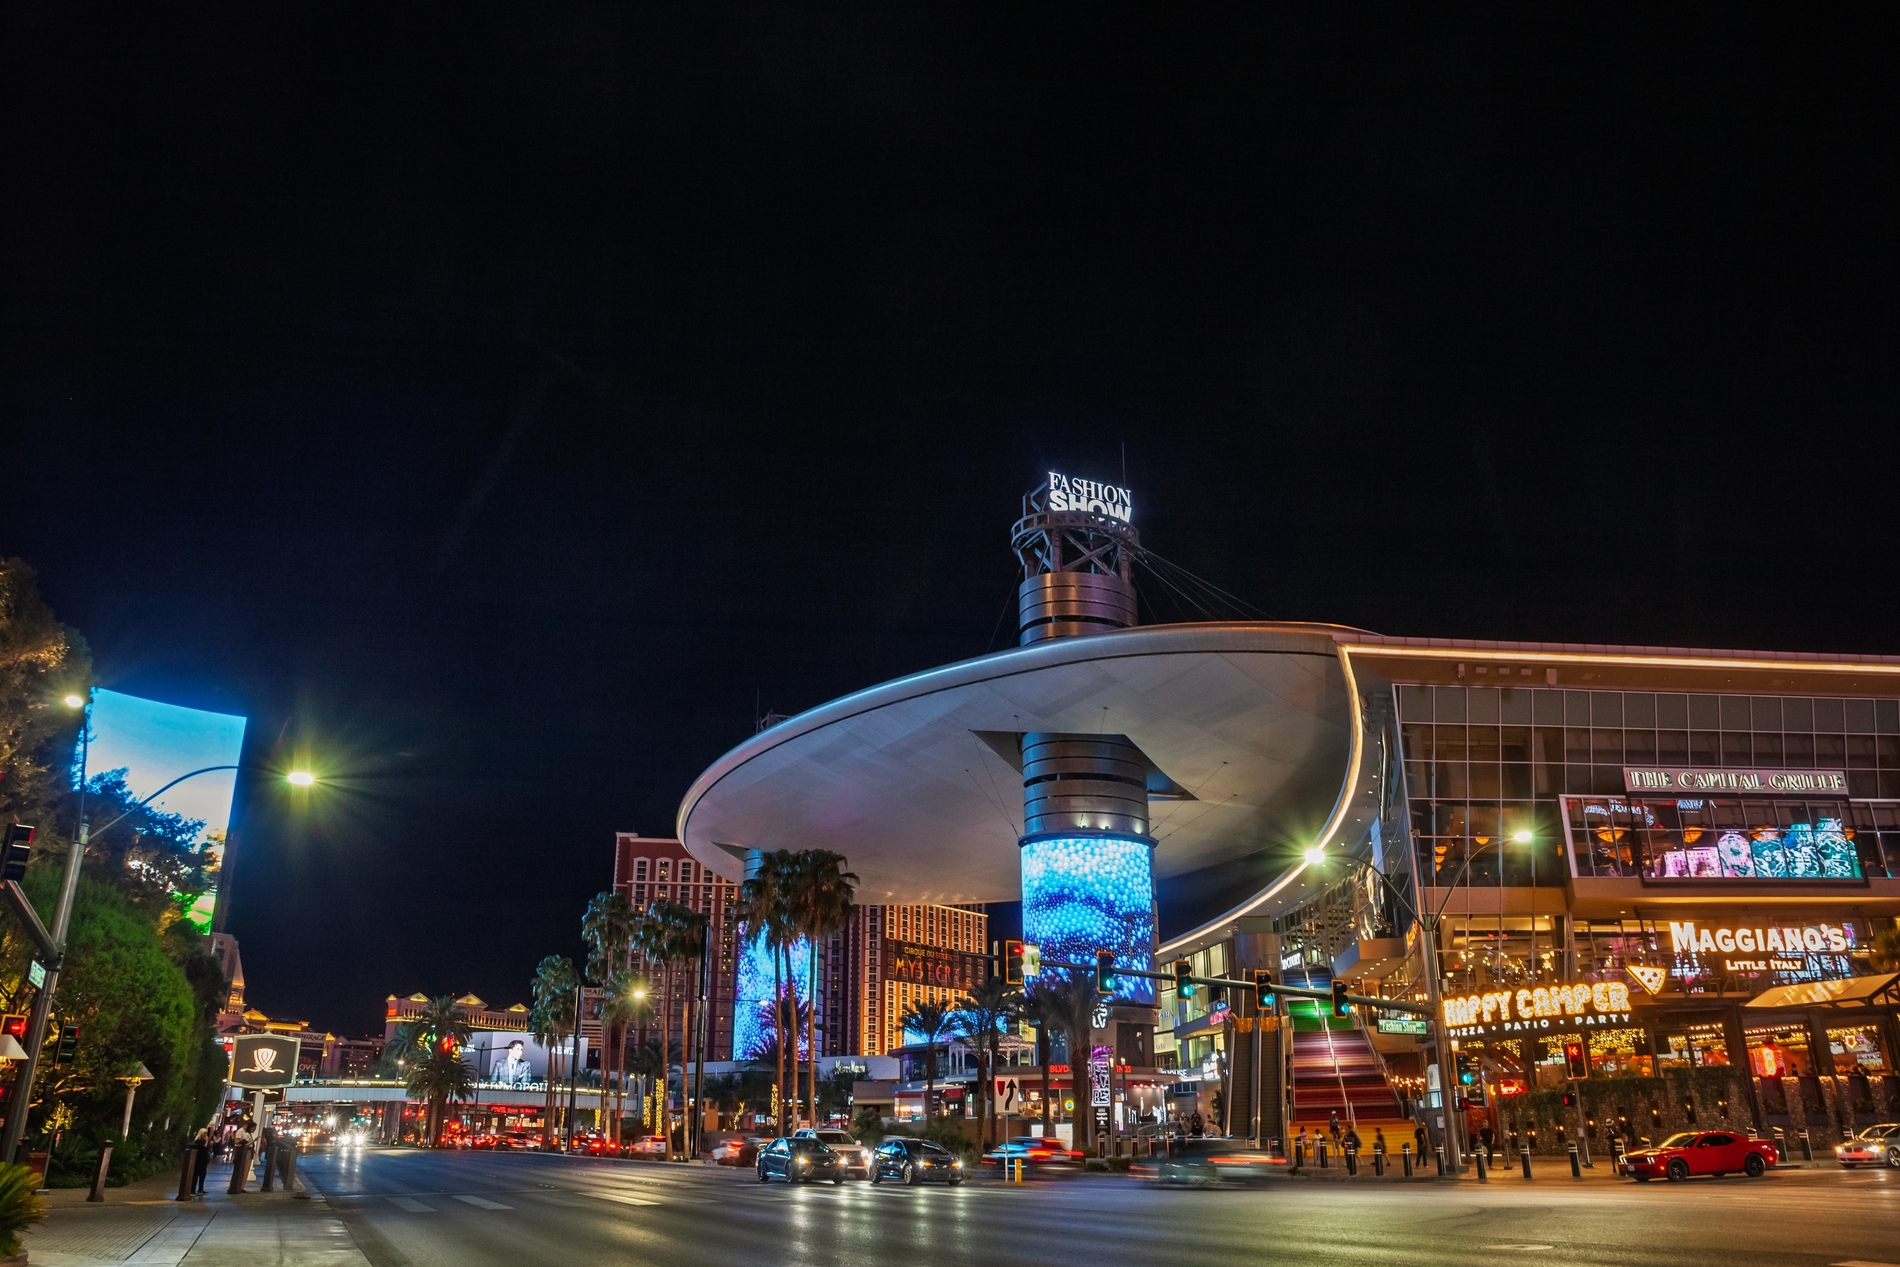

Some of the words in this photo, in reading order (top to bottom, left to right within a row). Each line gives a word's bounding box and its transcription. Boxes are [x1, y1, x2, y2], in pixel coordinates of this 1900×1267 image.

[1048, 472, 1132, 507] FASHION
[1049, 490, 1132, 524] SHOW
[1628, 771, 1673, 788] THE
[1677, 771, 1765, 789] CAPITAL
[1768, 773, 1845, 790] GRILLE
[1669, 921, 1847, 952] MAGGIANO'S
[904, 946, 925, 957] CIRQUE
[1726, 959, 1767, 971] LITTLE
[1770, 959, 1802, 970] ITALY
[1443, 992, 1512, 1027] HAPPY
[1516, 982, 1632, 1018] CAMPER
[1382, 1022, 1402, 1031] Fashion
[1402, 1022, 1416, 1032] Show
[1450, 1027, 1485, 1037] PIZZA
[1504, 1019, 1549, 1031] PATIO
[1575, 1014, 1630, 1025] PARTY
[300, 1034, 325, 1042] MIRAGE
[298, 1063, 317, 1072] OVE
[1049, 1065, 1069, 1073] BLVD
